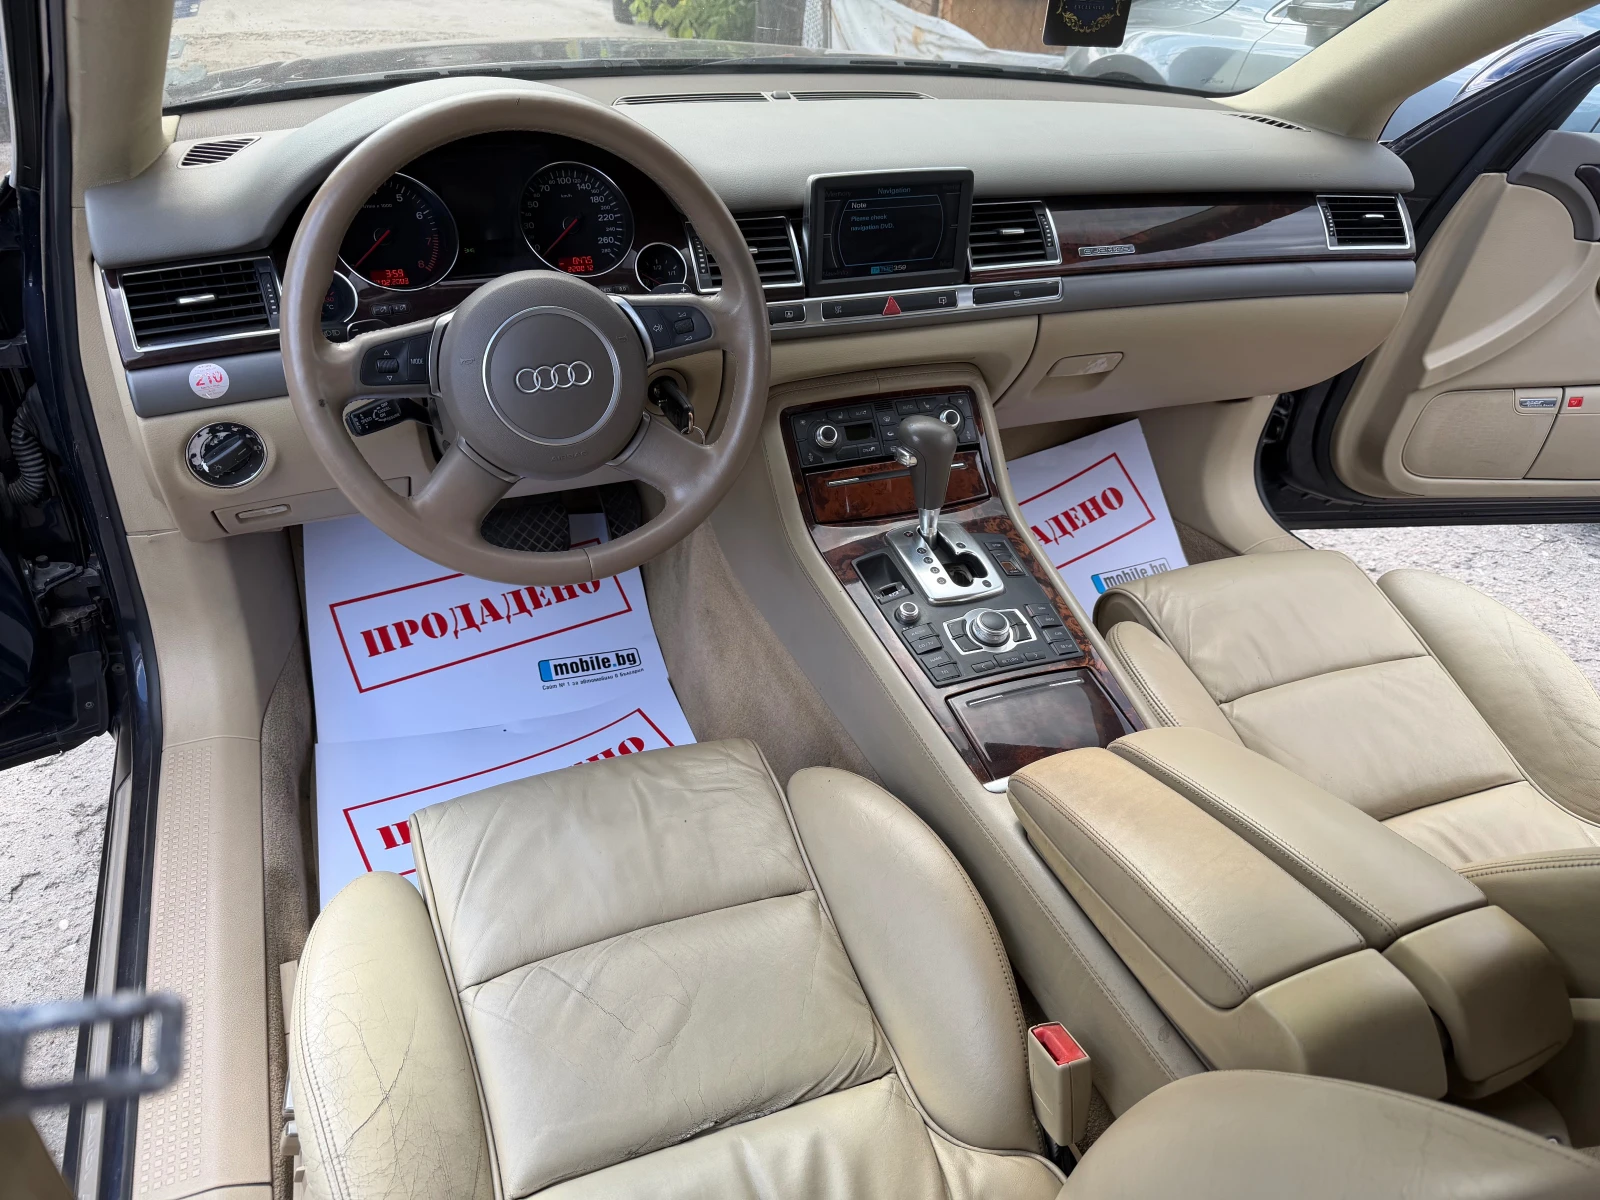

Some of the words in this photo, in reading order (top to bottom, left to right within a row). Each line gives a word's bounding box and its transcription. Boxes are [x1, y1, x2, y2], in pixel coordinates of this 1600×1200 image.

[556, 176, 572, 185] 100
[540, 184, 551, 192] 70
[576, 182, 592, 191] 140
[877, 186, 912, 195] Navigation
[395, 193, 404, 203] 5
[590, 195, 605, 204] 180
[527, 200, 540, 209] 50
[415, 211, 425, 221] 6
[597, 213, 614, 222] 220
[870, 213, 888, 221] check
[850, 224, 879, 232] navigation
[425, 237, 432, 246] 7
[597, 236, 614, 244] 260
[417, 259, 425, 269] 8
[409, 358, 425, 366] MODE
[360, 579, 601, 658] ПРОДАДЕНО
[554, 652, 637, 677] mobile.bg
